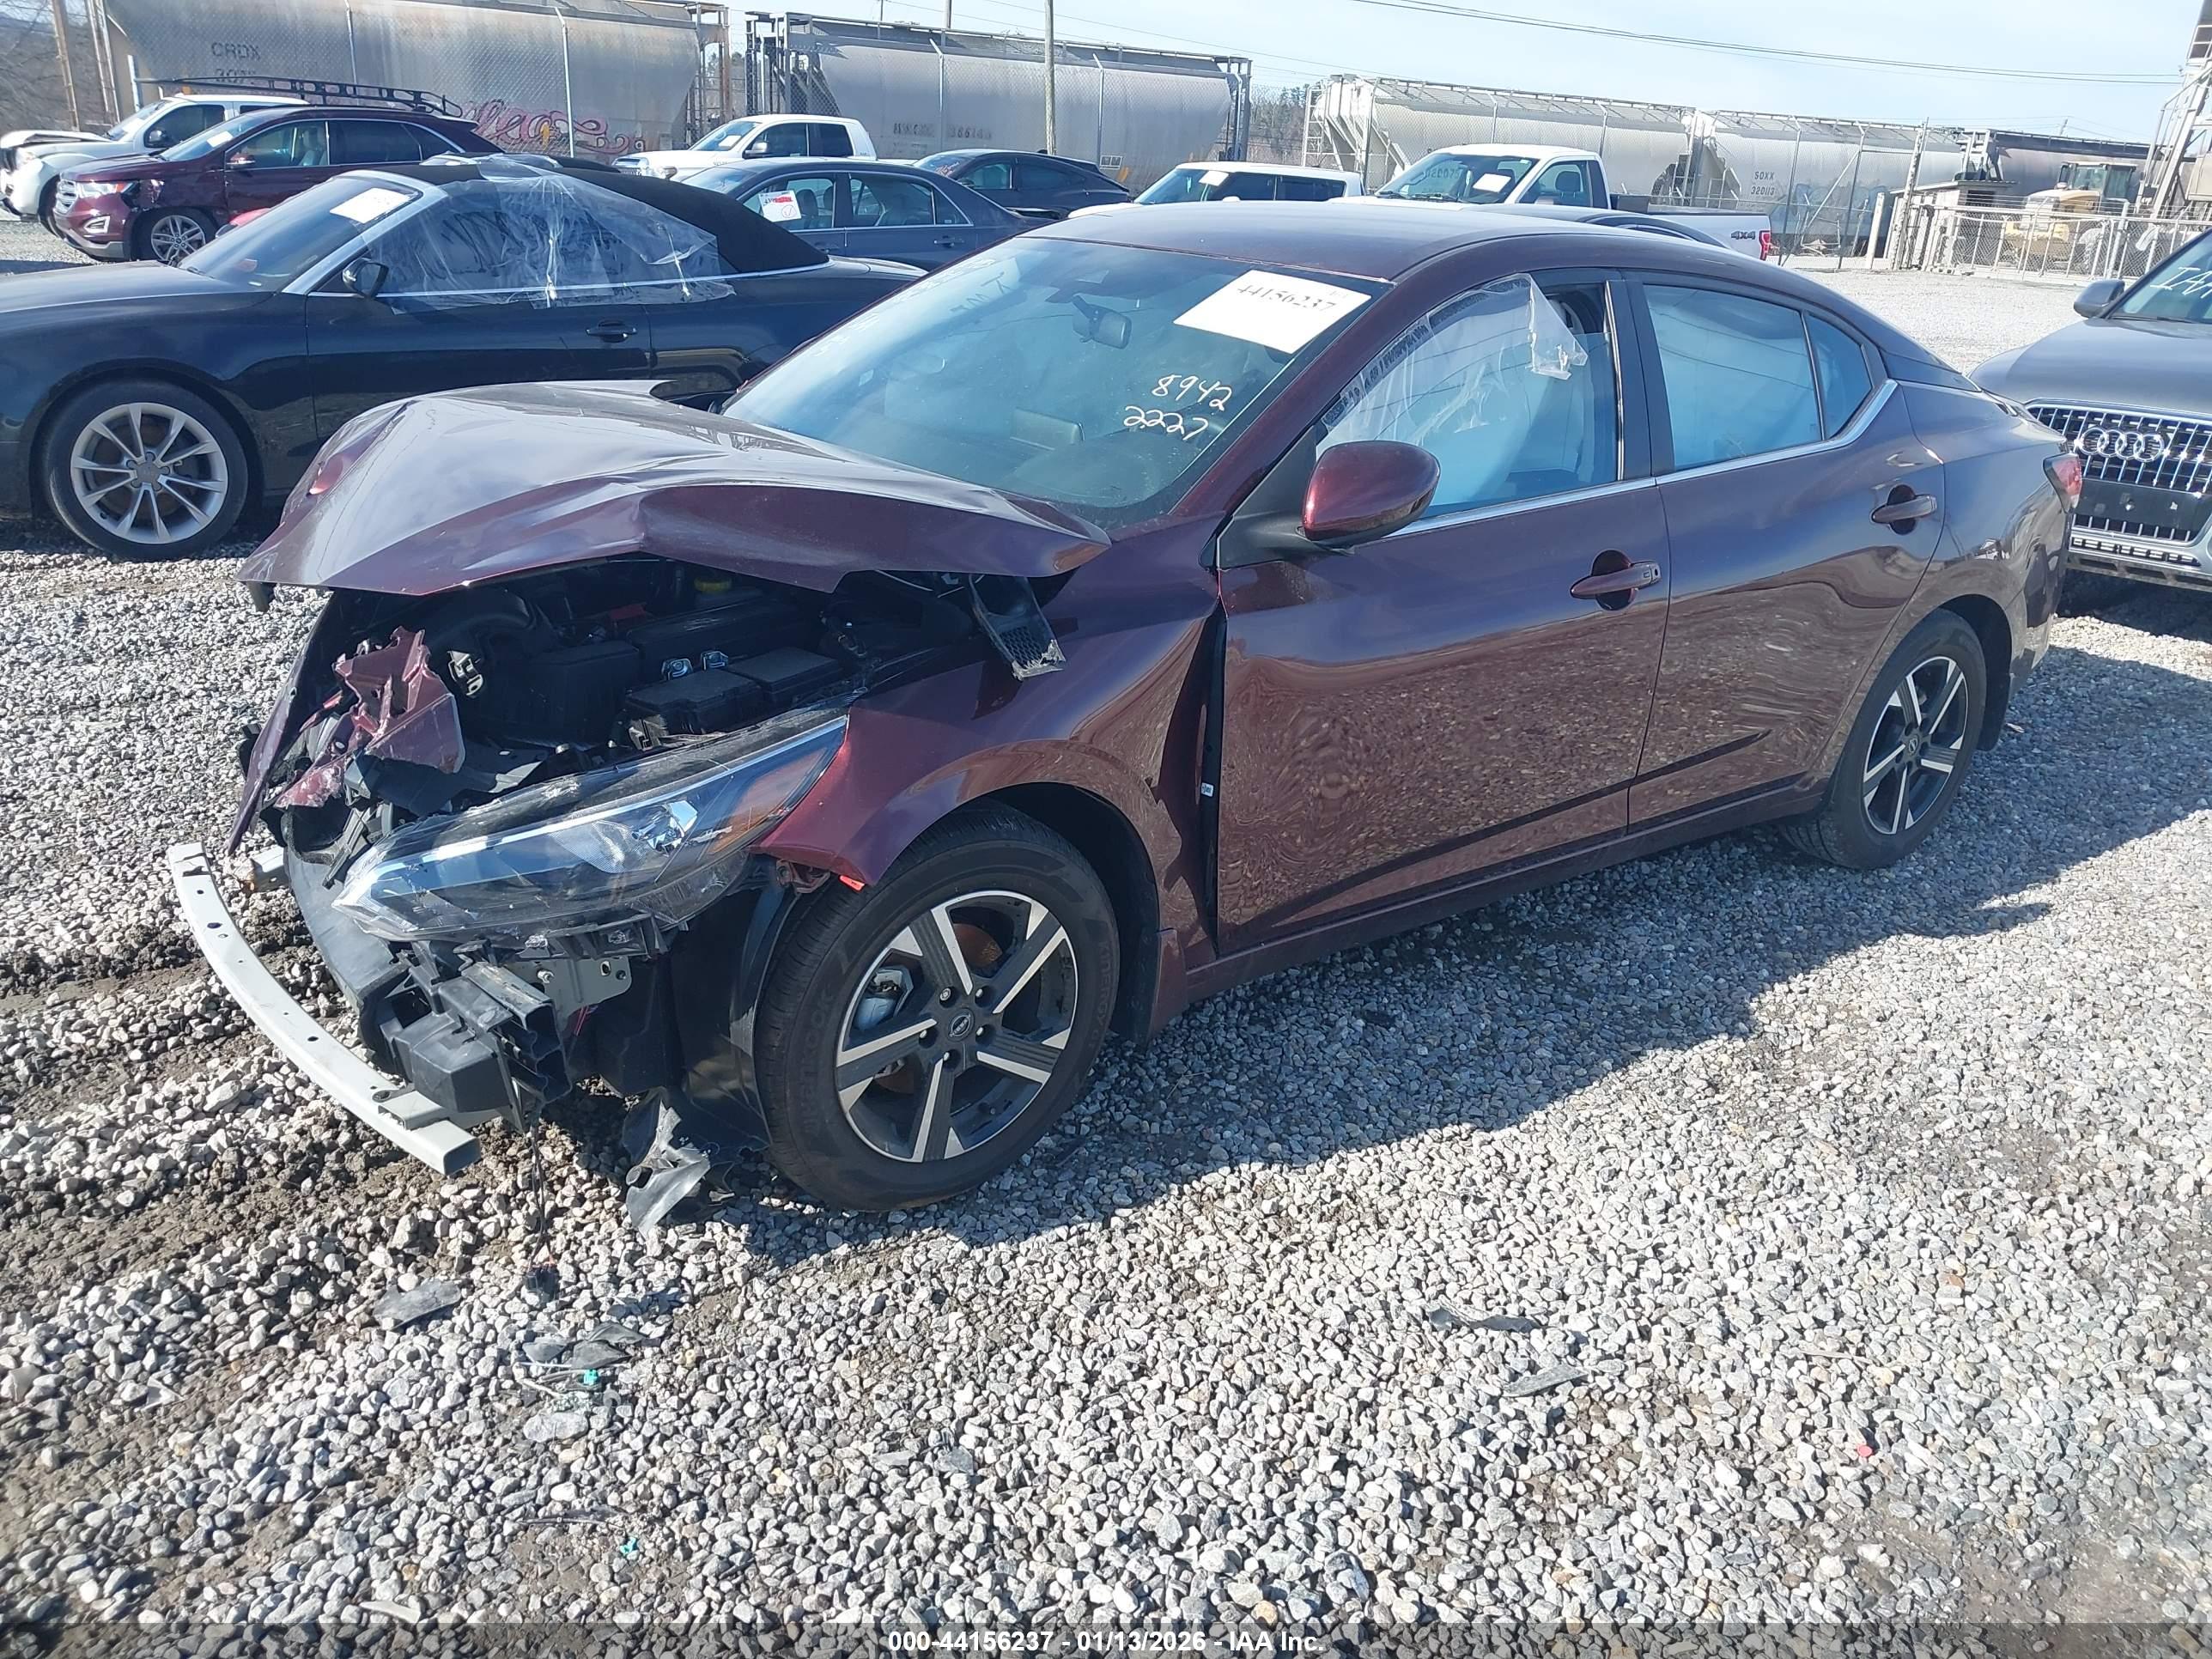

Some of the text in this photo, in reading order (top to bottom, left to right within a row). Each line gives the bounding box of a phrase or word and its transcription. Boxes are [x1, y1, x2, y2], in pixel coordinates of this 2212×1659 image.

[211, 42, 261, 61] CRDX
[1754, 171, 1775, 179] SOXX
[1751, 185, 1775, 196] 320113
[1237, 285, 1336, 311] 44156237
[1152, 374, 1232, 411] 8942
